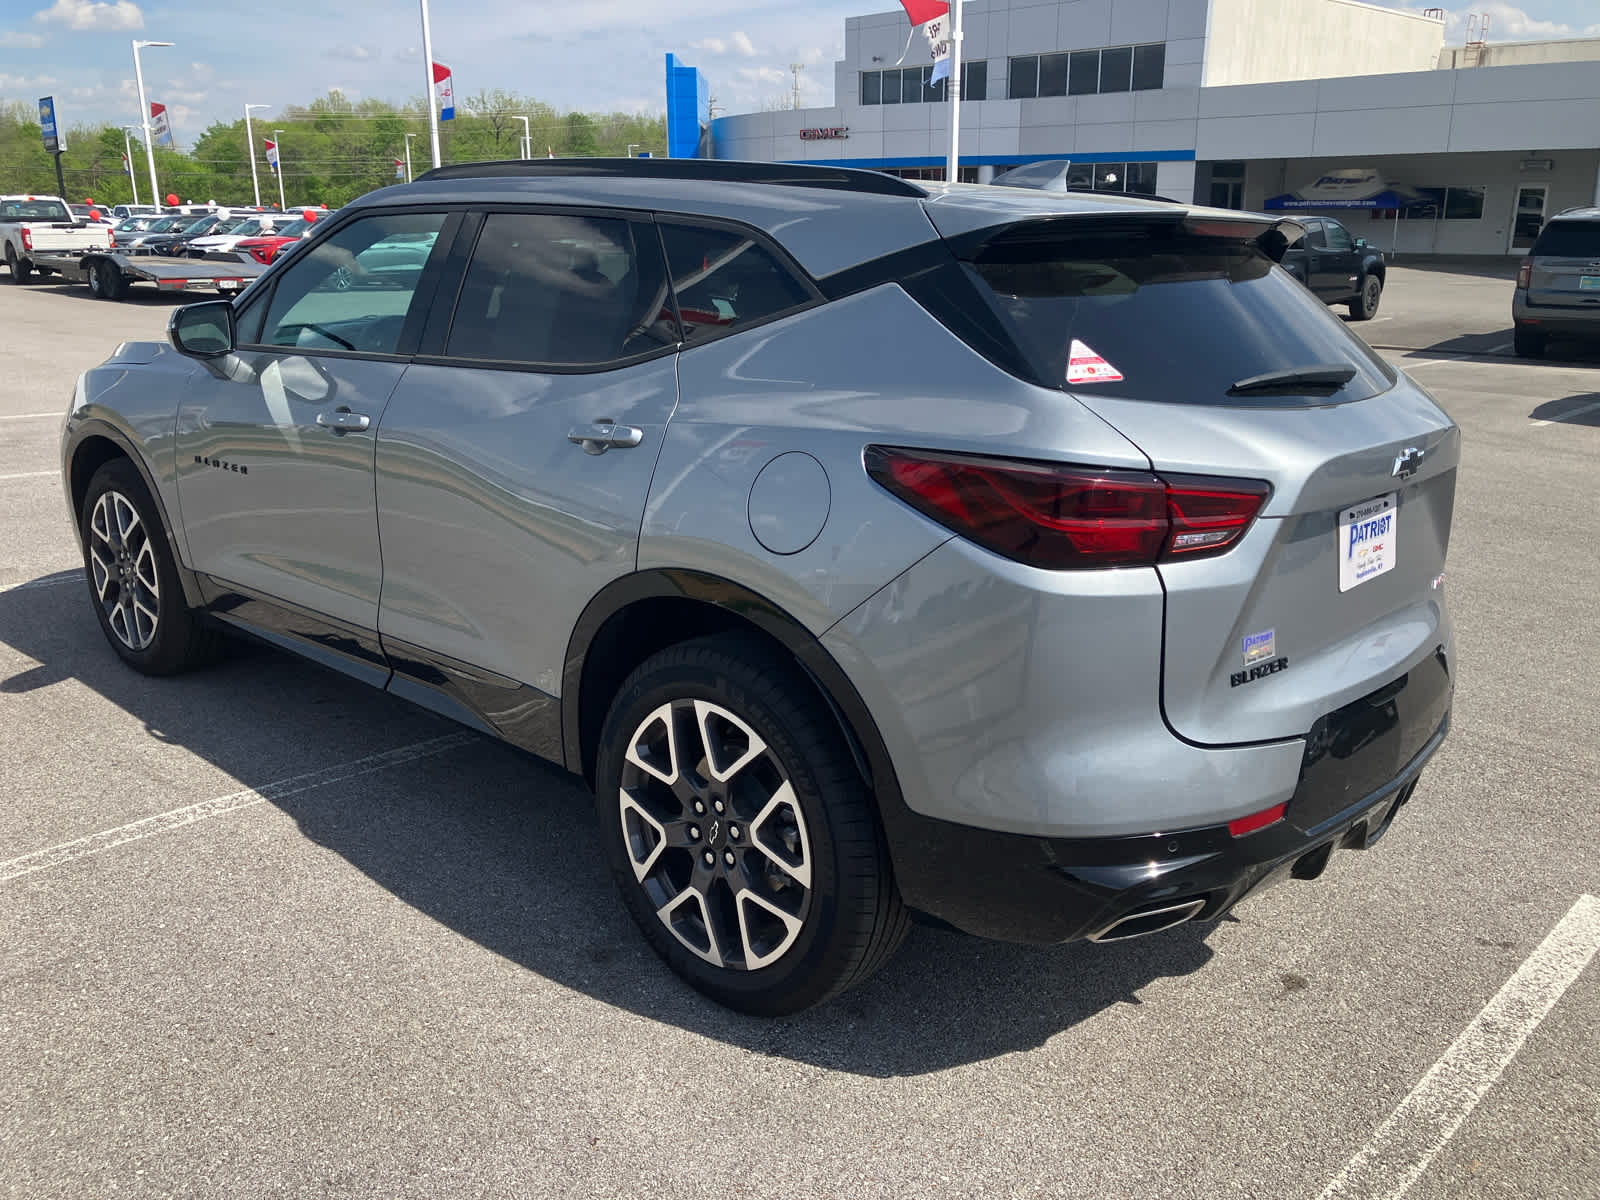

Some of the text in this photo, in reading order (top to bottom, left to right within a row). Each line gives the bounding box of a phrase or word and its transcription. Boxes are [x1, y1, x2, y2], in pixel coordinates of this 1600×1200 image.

[799, 127, 845, 140] GMC
[194, 455, 248, 475] BLAZER
[1348, 515, 1391, 559] PATRIOT
[1230, 656, 1289, 688] BLAZER
